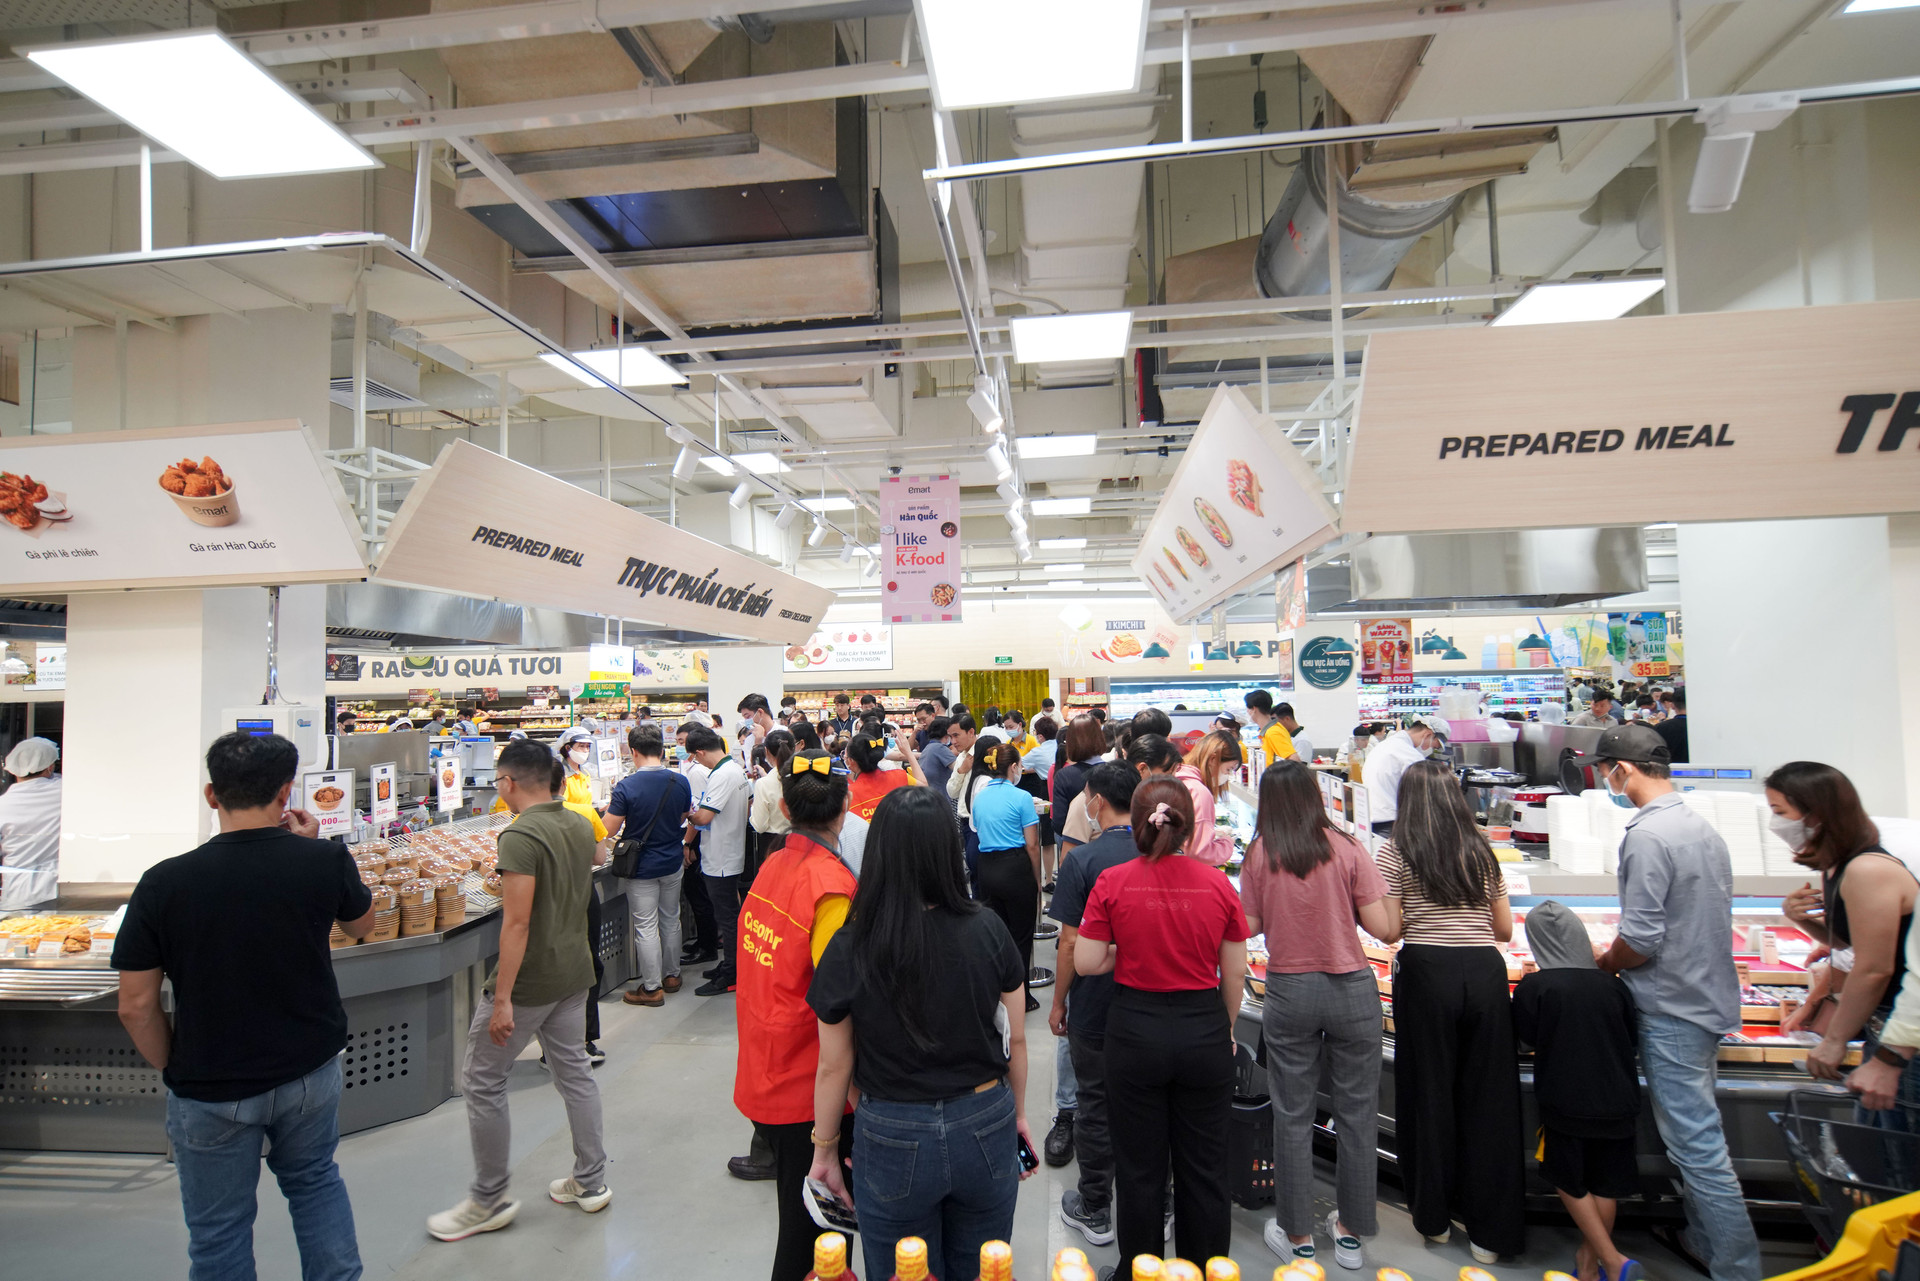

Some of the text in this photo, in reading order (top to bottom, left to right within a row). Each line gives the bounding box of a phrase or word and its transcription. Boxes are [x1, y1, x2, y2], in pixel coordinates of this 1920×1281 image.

[1439, 423, 1735, 460] PREPARED MEAL
[192, 504, 229, 517] emart
[900, 510, 938, 521] Hàn Quốc
[189, 538, 276, 552] Gà rán Hàn Quốc
[896, 532, 927, 545] I like
[471, 525, 585, 567] PREPARED MEAL
[25, 547, 99, 560] Gà phi lê chiên
[896, 551, 944, 566] K-food
[617, 556, 774, 618] THỰC PHẨM CHẾ BIẾN
[1113, 620, 1138, 630] KIMCHI
[1648, 616, 1664, 629] SỮA
[508, 656, 562, 676] TƯƠI
[1637, 663, 1651, 676] 35
